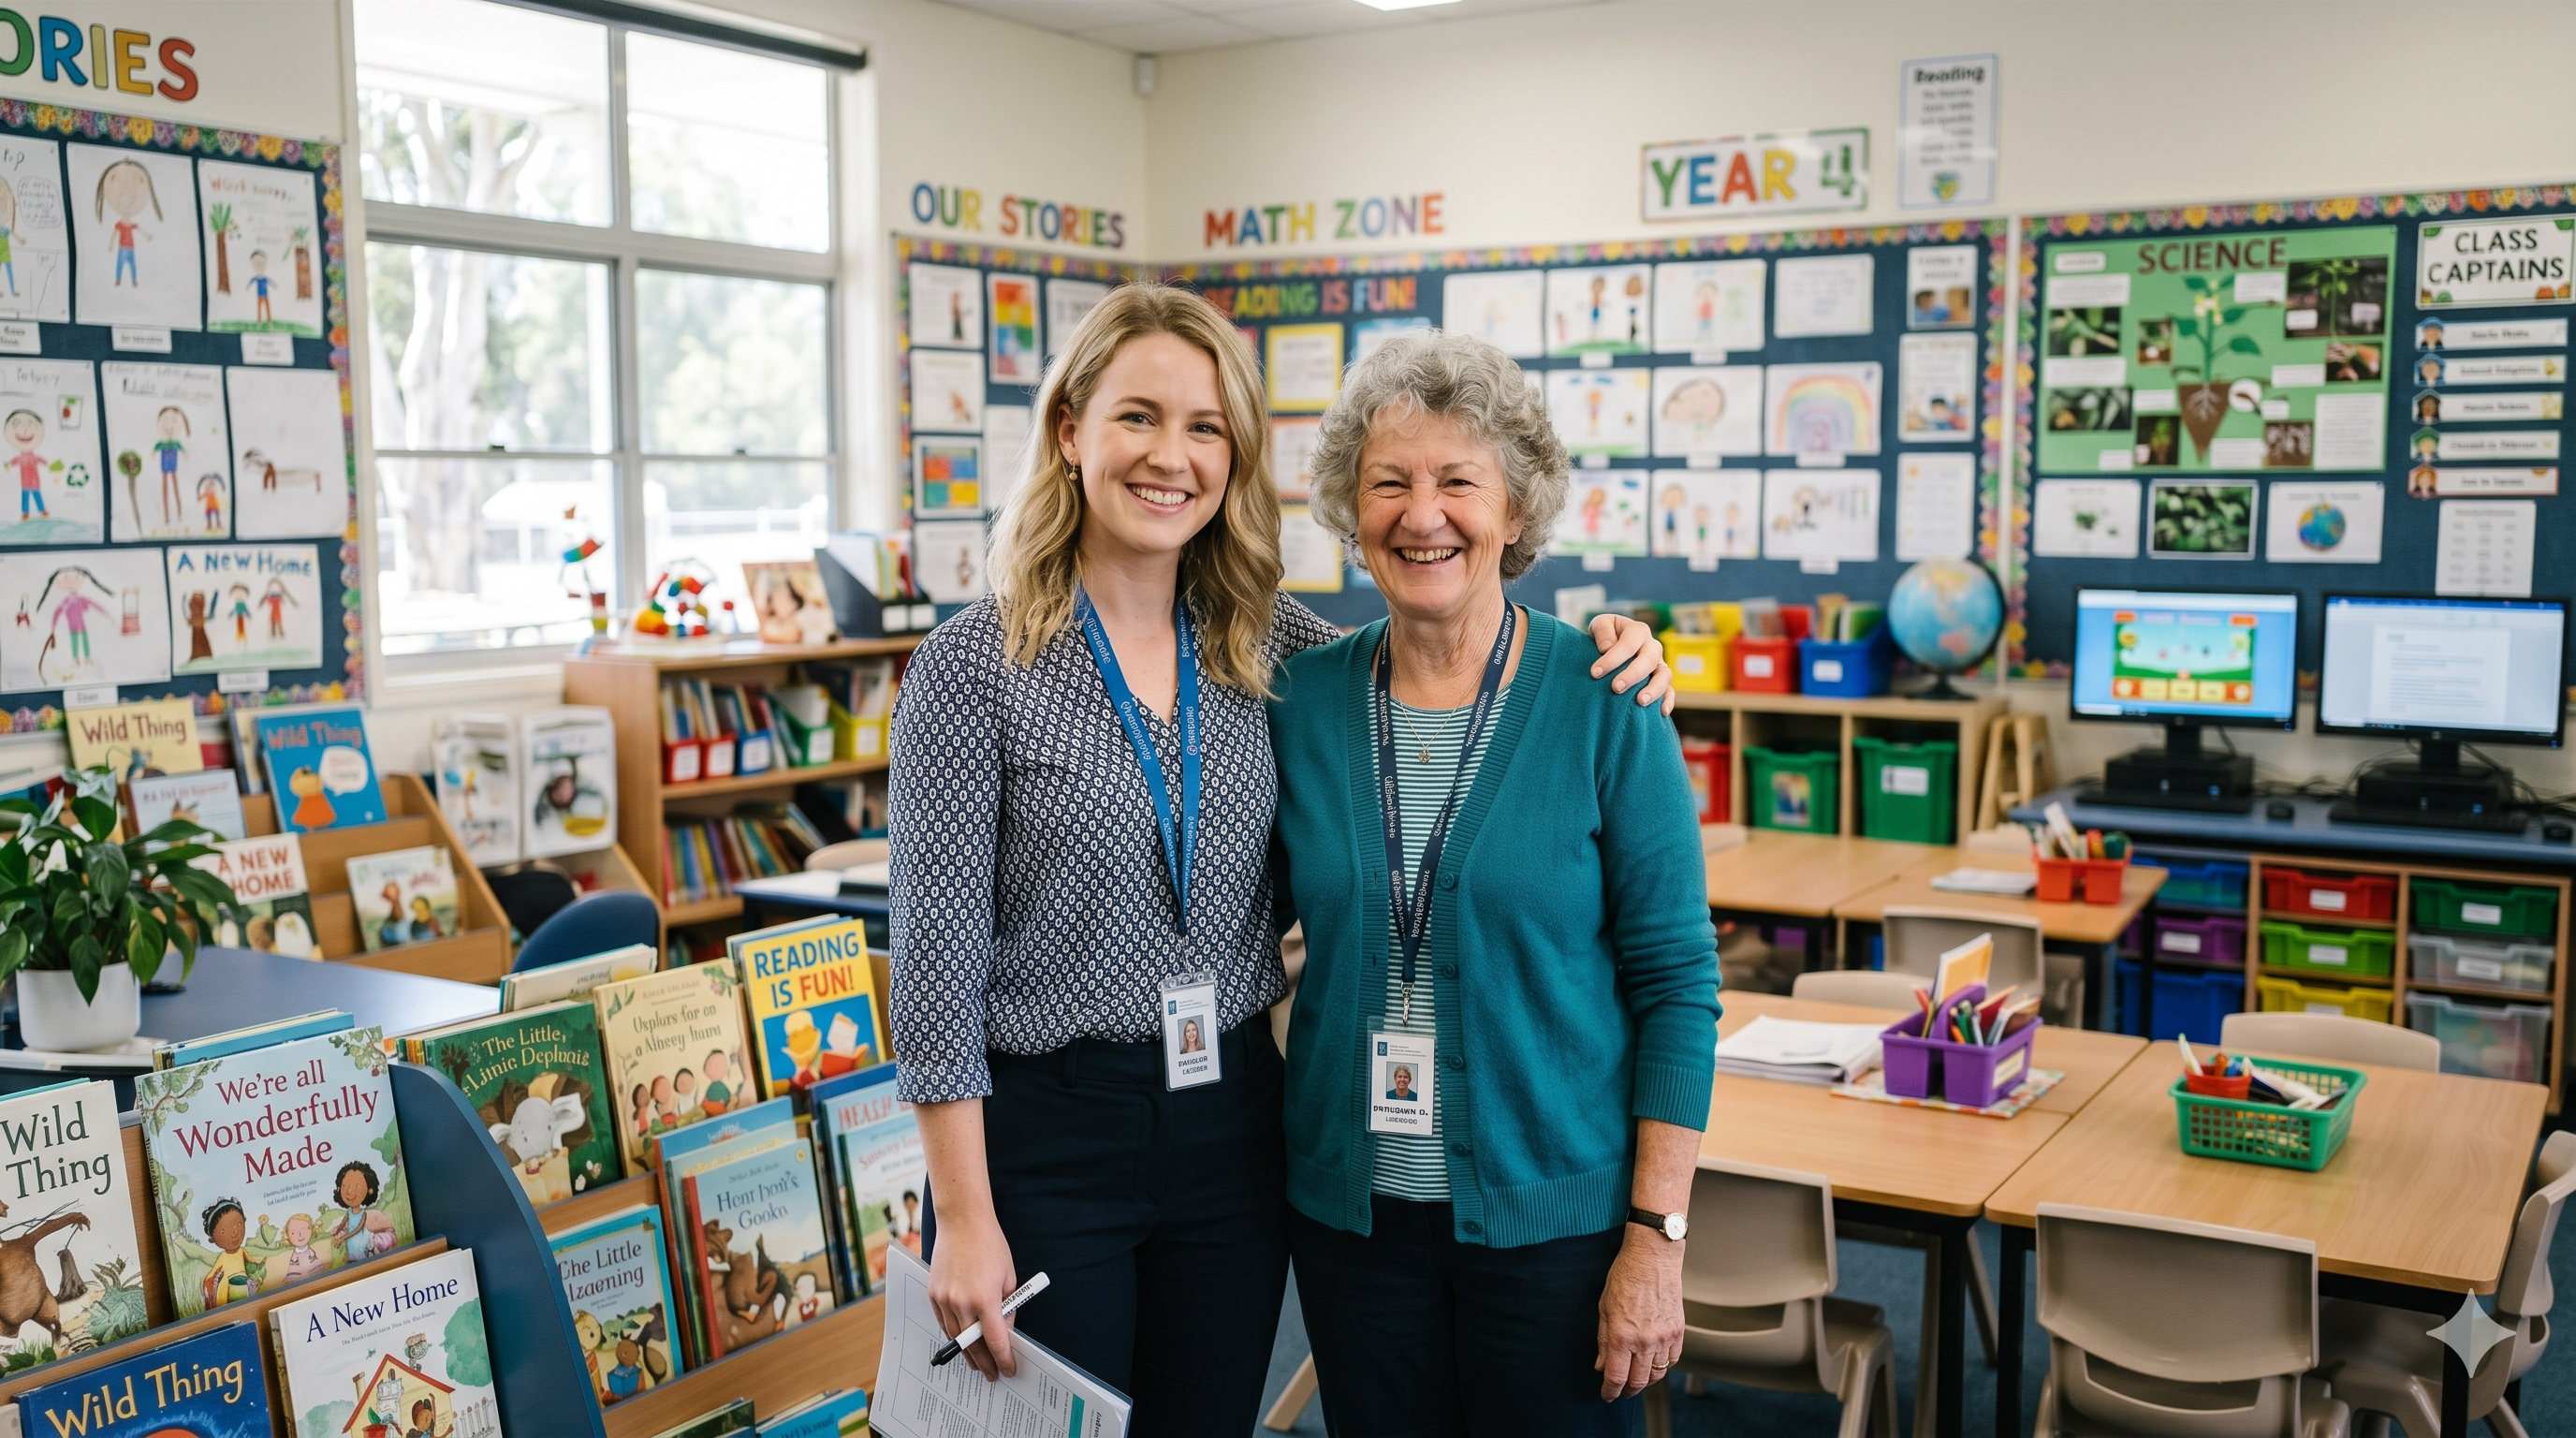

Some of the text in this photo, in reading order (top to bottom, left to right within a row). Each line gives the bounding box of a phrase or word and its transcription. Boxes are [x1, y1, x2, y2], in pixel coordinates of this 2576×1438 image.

[1650, 143, 1855, 208] YEAR 4
[912, 183, 1126, 250] OUR STORIES
[1204, 192, 1445, 248] MATH ZONE
[2137, 237, 2289, 275] SCIENCE
[2454, 228, 2539, 256] CLASS
[2427, 257, 2565, 285] CAPTAINS
[1321, 279, 1349, 315] IS
[1354, 276, 1417, 314] FUN!
[177, 551, 194, 574] A
[257, 551, 312, 576] Home
[80, 712, 186, 746] Wild Thing
[267, 722, 363, 750] Wild Thing
[218, 846, 288, 875] A NEW
[231, 868, 295, 896] HOME
[754, 931, 861, 979] READING
[770, 963, 856, 1010] IS FUN!
[482, 1036, 515, 1057] The
[215, 1059, 326, 1106] We're all
[0, 1100, 90, 1155] Wild
[173, 1084, 379, 1160] Wonderfully
[6, 1153, 111, 1199] Thing
[243, 1137, 333, 1184] Made
[596, 1240, 642, 1269] Little
[306, 1312, 327, 1343] A
[331, 1300, 386, 1333] New
[391, 1278, 459, 1313] Home
[45, 1360, 242, 1438] Wild Thing
